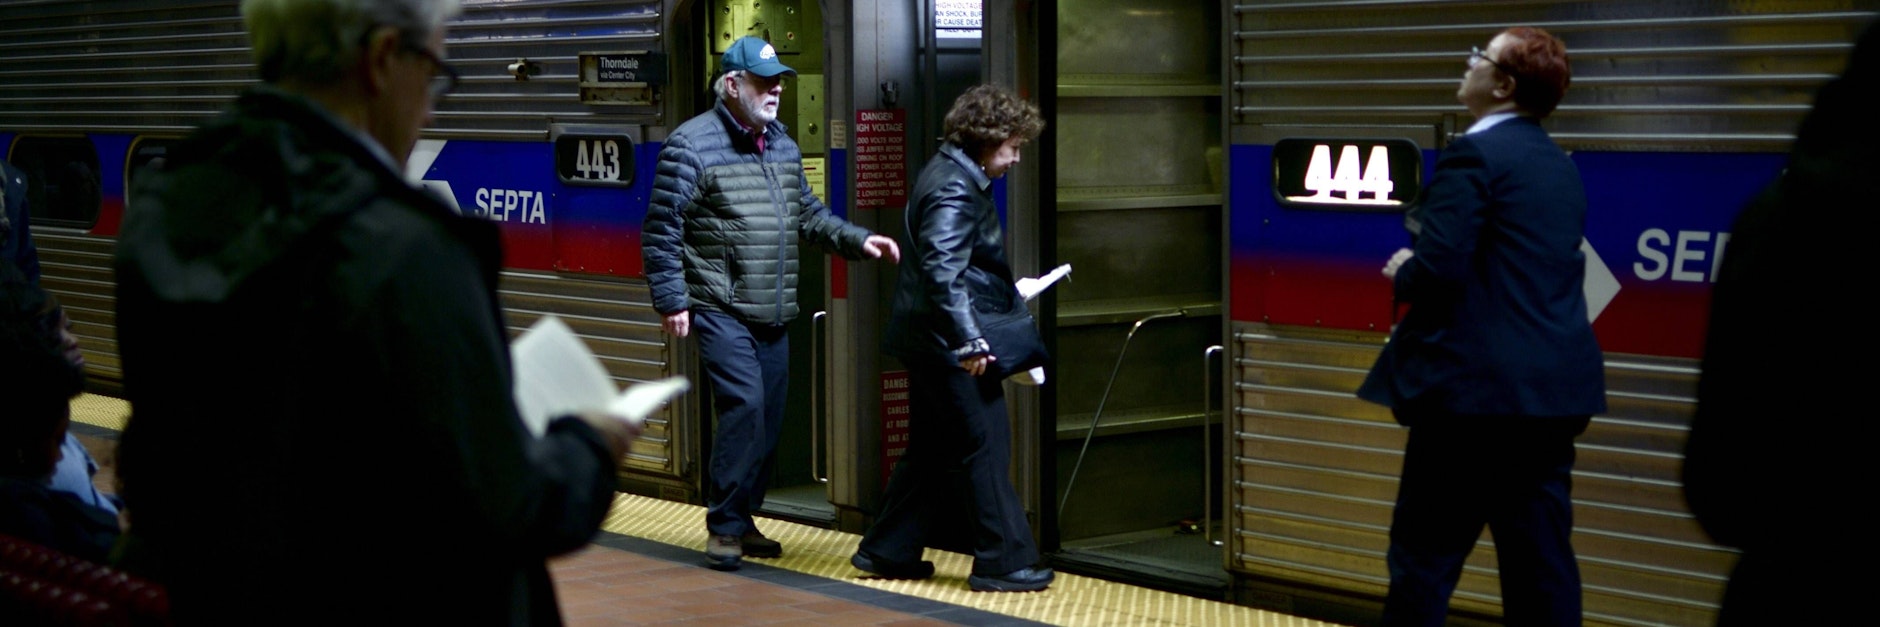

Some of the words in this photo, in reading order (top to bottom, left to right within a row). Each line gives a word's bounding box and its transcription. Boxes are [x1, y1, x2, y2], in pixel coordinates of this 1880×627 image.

[600, 56, 639, 69] Thorndale
[600, 71, 608, 79] via
[608, 71, 625, 79] Center
[625, 71, 636, 81] City
[861, 112, 894, 121] DANGER
[871, 122, 904, 132] VOLTAGE
[576, 139, 620, 180] 443
[861, 163, 880, 171] POWER
[1305, 144, 1394, 200] 444
[862, 171, 884, 180] EITHER
[861, 189, 890, 198] LOWERED
[891, 188, 905, 196] AND
[474, 187, 546, 225] SEPTA
[887, 405, 910, 415] CABLES
